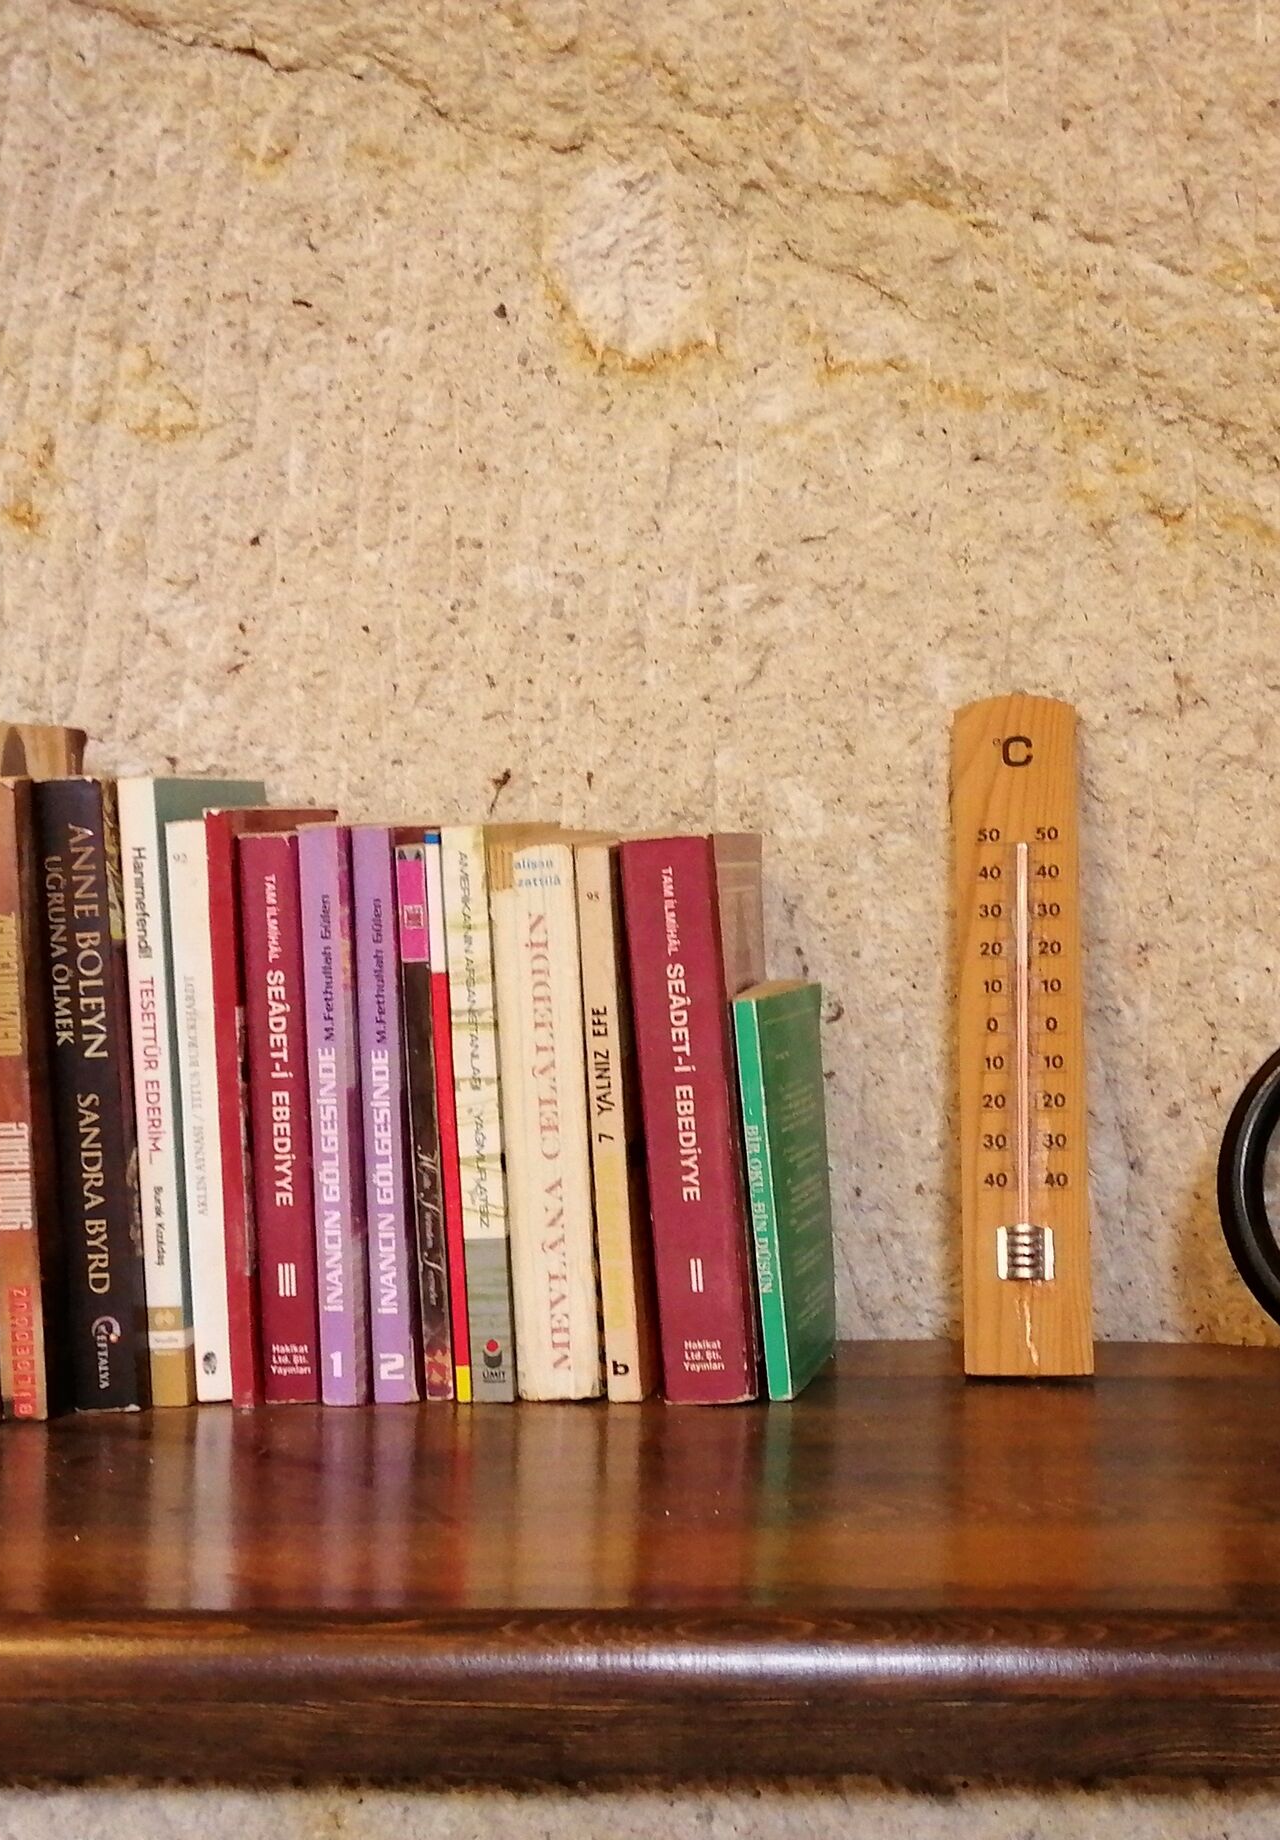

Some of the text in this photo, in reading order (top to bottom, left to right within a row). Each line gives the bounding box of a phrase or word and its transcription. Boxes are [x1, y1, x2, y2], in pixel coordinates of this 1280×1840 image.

[977, 828, 1059, 842] 50 50
[264, 874, 277, 904] TAM
[661, 866, 675, 899] TAM
[977, 865, 1060, 881] 40 40
[978, 903, 1061, 918] 30 30
[44, 856, 74, 1047] UĞRUNA ÖLMEK
[67, 823, 109, 1059] ANNE BOLEYN
[979, 940, 1062, 957] 20 20
[983, 978, 1062, 995] 10 10
[140, 977, 159, 1071] TESETTÜR
[267, 969, 293, 1078] SEÂDET-İ
[666, 963, 696, 1073] SEÂDET-İ
[986, 1017, 1058, 1033] 0 0
[524, 911, 561, 1161] CELÂLEDDİN
[591, 1006, 615, 1143] 7 YALNIZ EFE
[984, 1055, 1064, 1071] 10 10
[982, 1094, 1066, 1110] 20 20
[316, 1047, 342, 1203] GÖLGESİNDE
[371, 1049, 395, 1205] GÖLGESİNDE
[745, 1124, 762, 1153] BİR
[272, 1091, 296, 1207] EBEDİYYE
[676, 1084, 702, 1202] EBEDİYYE
[983, 1133, 1068, 1150] 30 30
[75, 1093, 111, 1294] SANDRA BYRD
[984, 1172, 1069, 1188] 40 40
[752, 1201, 769, 1232] BİN
[324, 1210, 345, 1312] İNANCIN
[378, 1212, 399, 1314] İNANCIN
[541, 1177, 572, 1370] MEVLÂNA
[688, 1258, 704, 1293] II
[272, 1344, 308, 1353] Hakikat
[684, 1340, 721, 1349] Hakikat
[330, 1351, 343, 1378] 1
[379, 1352, 405, 1380] 2
